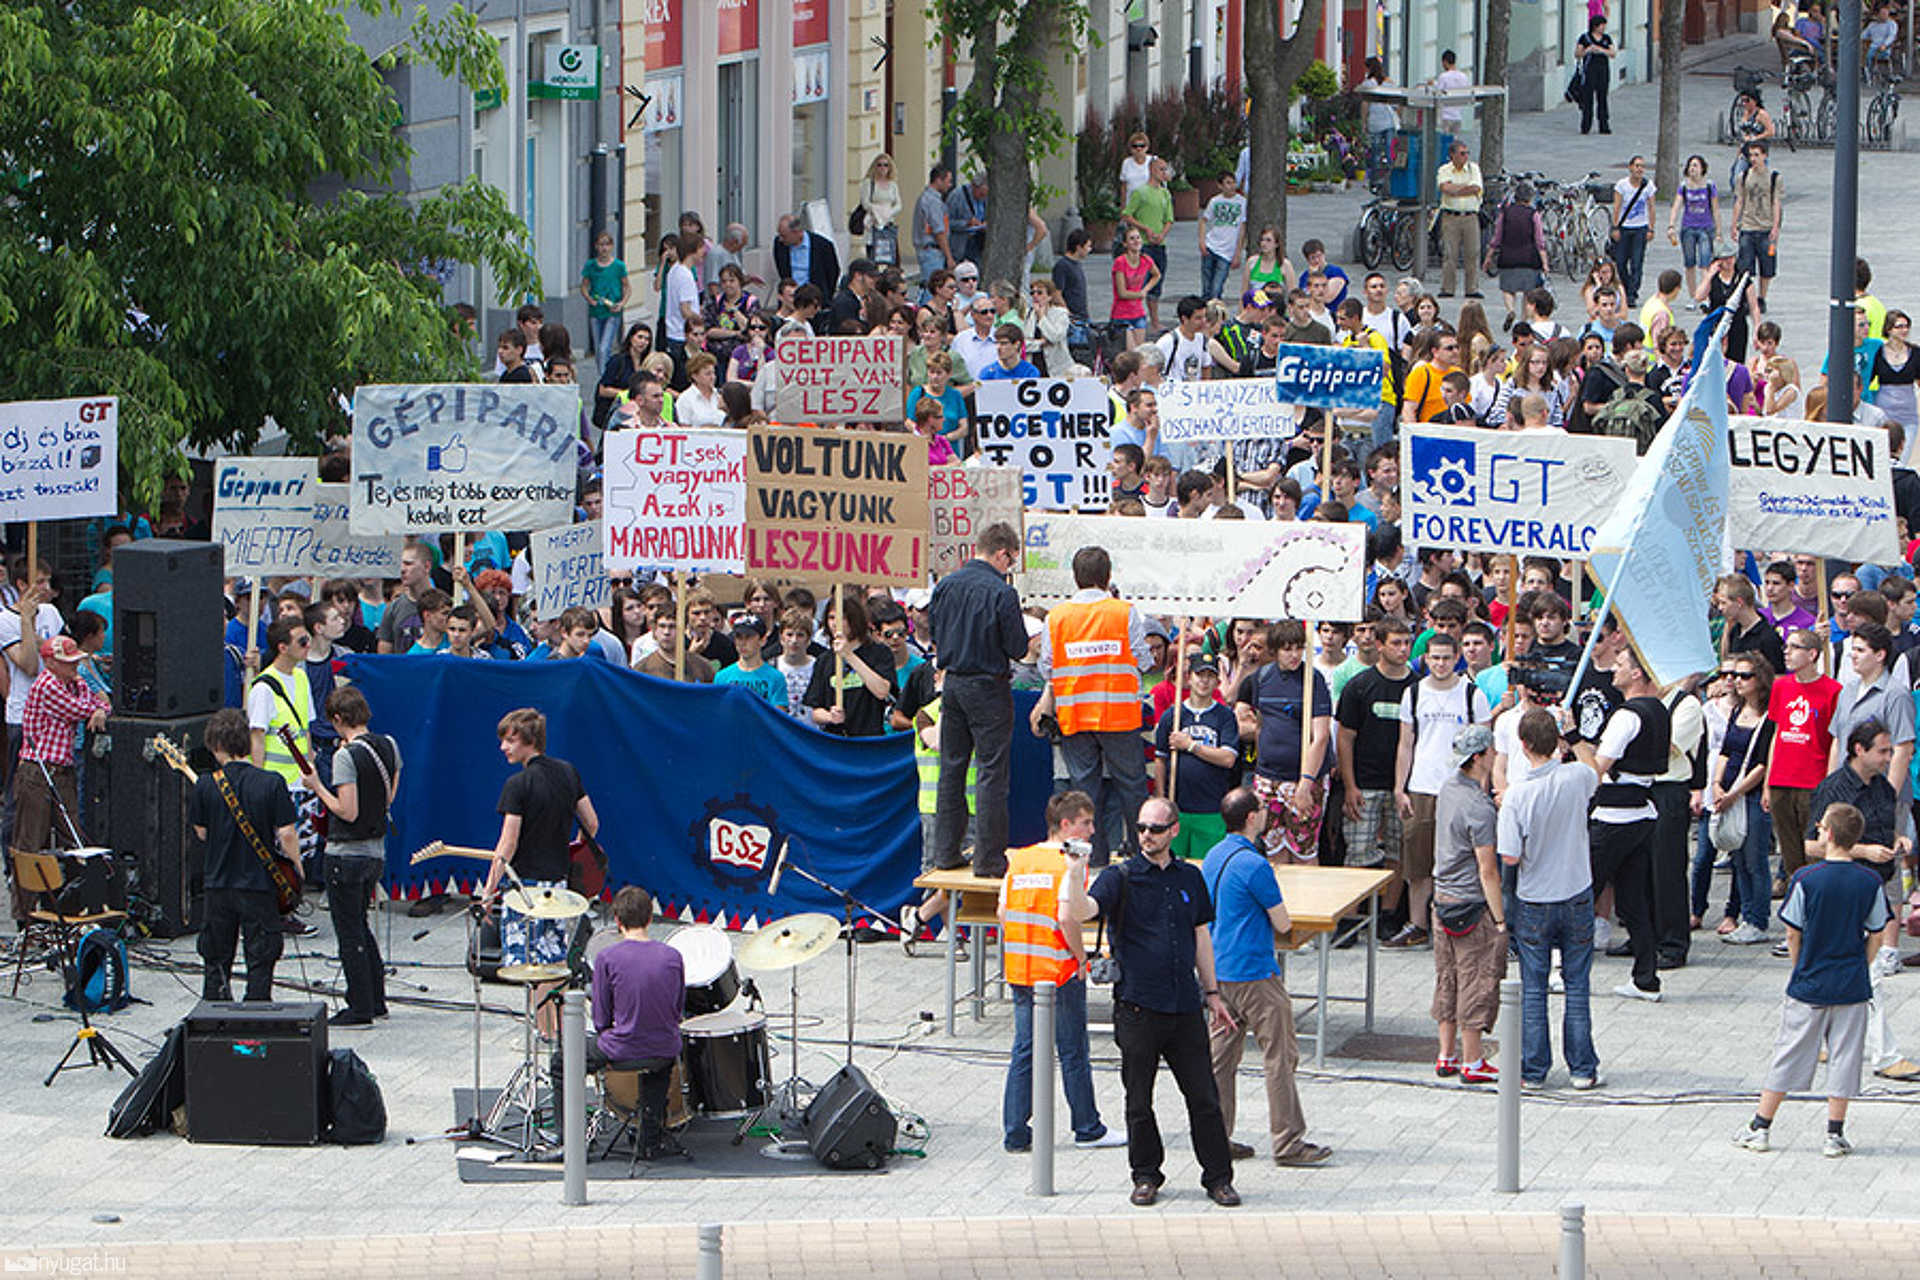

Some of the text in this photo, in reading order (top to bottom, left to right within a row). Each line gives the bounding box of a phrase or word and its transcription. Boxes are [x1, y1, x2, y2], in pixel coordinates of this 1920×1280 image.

[1278, 356, 1381, 393] Gépipari
[803, 388, 880, 415] LESZ
[1017, 380, 1071, 407] GO
[80, 402, 113, 423] GT
[367, 389, 577, 463] GÉPIPARI
[976, 411, 1111, 439] TOGETHER
[753, 434, 907, 483] VOLTUNK
[985, 443, 1097, 468] FOR
[1728, 429, 1876, 480] LEGYEN
[219, 465, 309, 504] Gépipari
[413, 480, 445, 504] még
[449, 480, 487, 501] több
[526, 480, 574, 502] ember
[1489, 453, 1566, 506] GT
[458, 507, 487, 525] ezt
[708, 502, 726, 517] is
[758, 488, 896, 524] VAGYUNK
[610, 522, 747, 561] MARADUNK!
